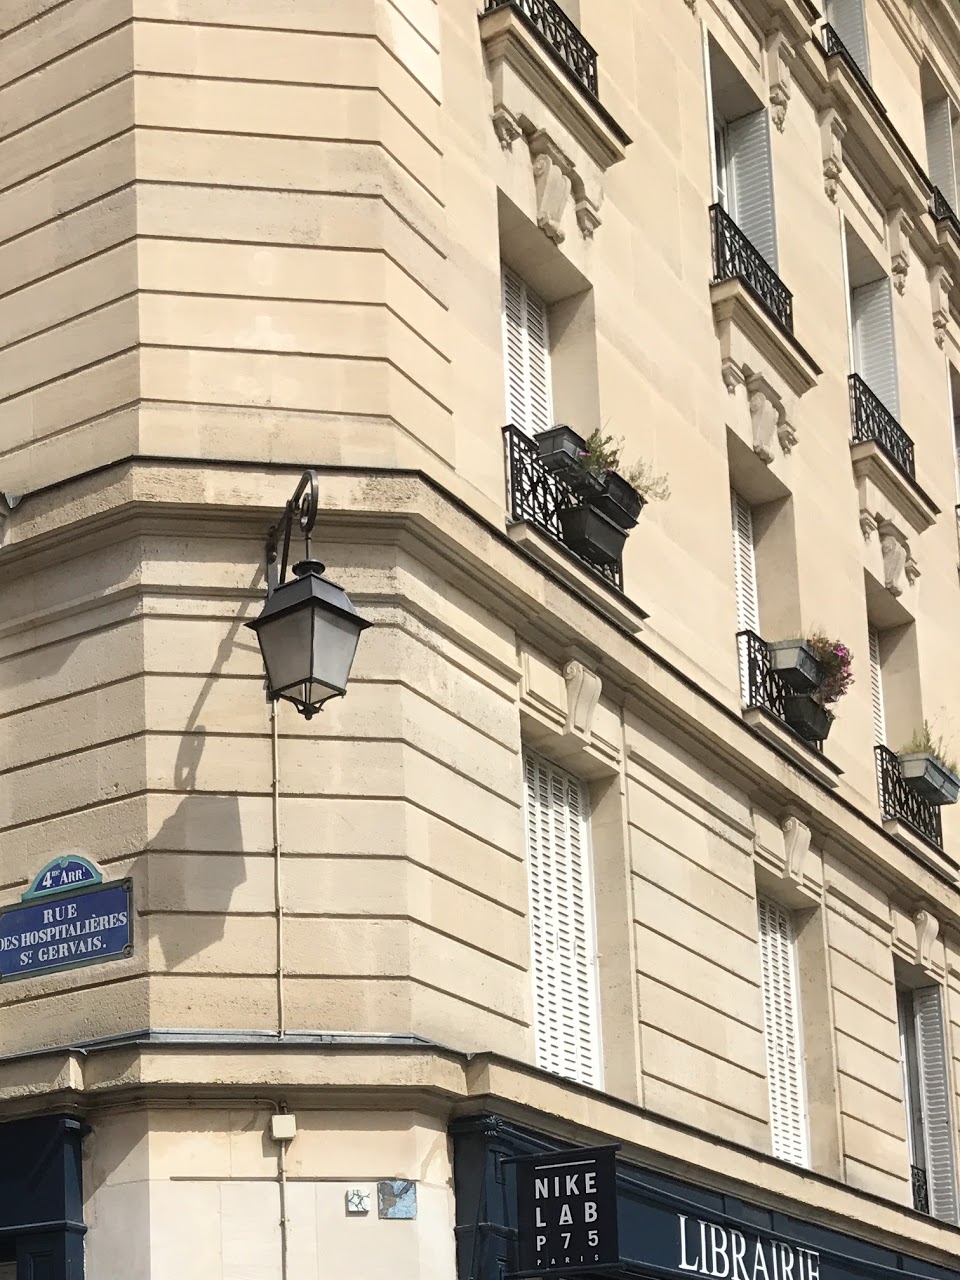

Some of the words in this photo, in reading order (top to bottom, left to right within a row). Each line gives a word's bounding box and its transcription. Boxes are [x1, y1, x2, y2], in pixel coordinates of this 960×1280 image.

[43, 903, 77, 924] RUE
[20, 912, 128, 947] HOSPITALIÈRES
[38, 935, 107, 962] GERVAIS.
[534, 1172, 597, 1199] NIKE
[537, 1254, 599, 1266] PARIS
